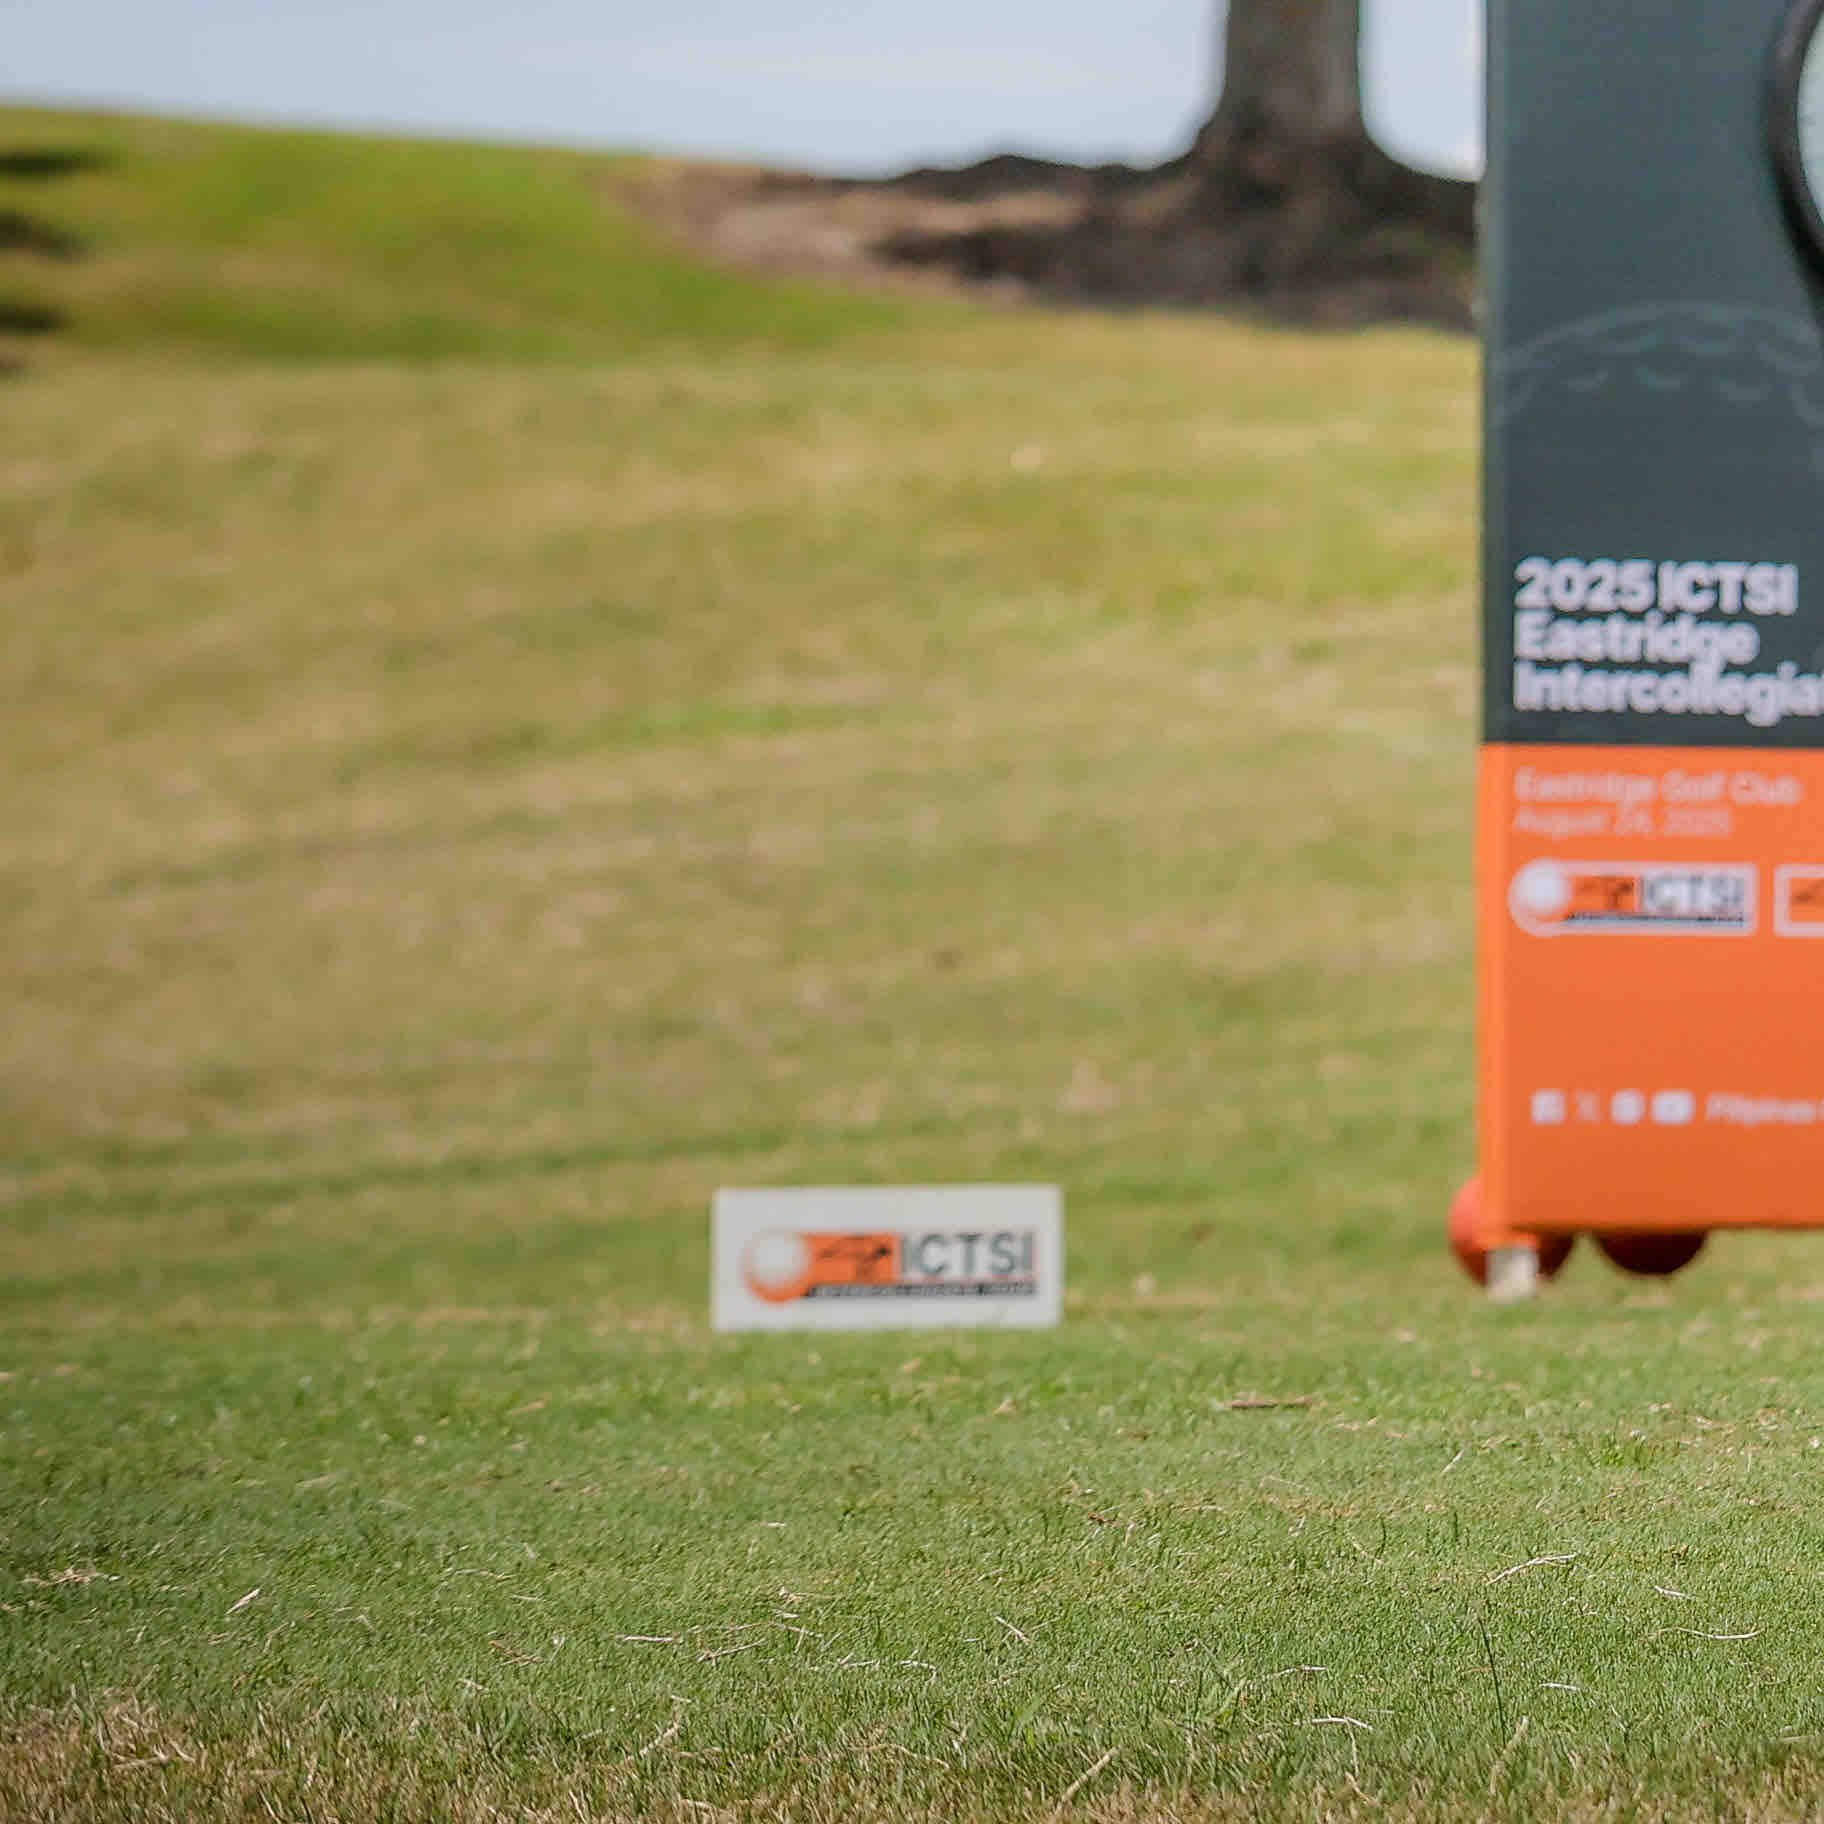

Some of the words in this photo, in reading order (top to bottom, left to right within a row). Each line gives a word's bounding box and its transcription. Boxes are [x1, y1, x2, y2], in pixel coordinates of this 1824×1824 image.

[1512, 555, 1656, 613] 2025
[1657, 559, 1799, 616] ICTSI
[1512, 608, 1760, 670] Eastridge
[901, 1232, 1034, 1276] ICTSI
